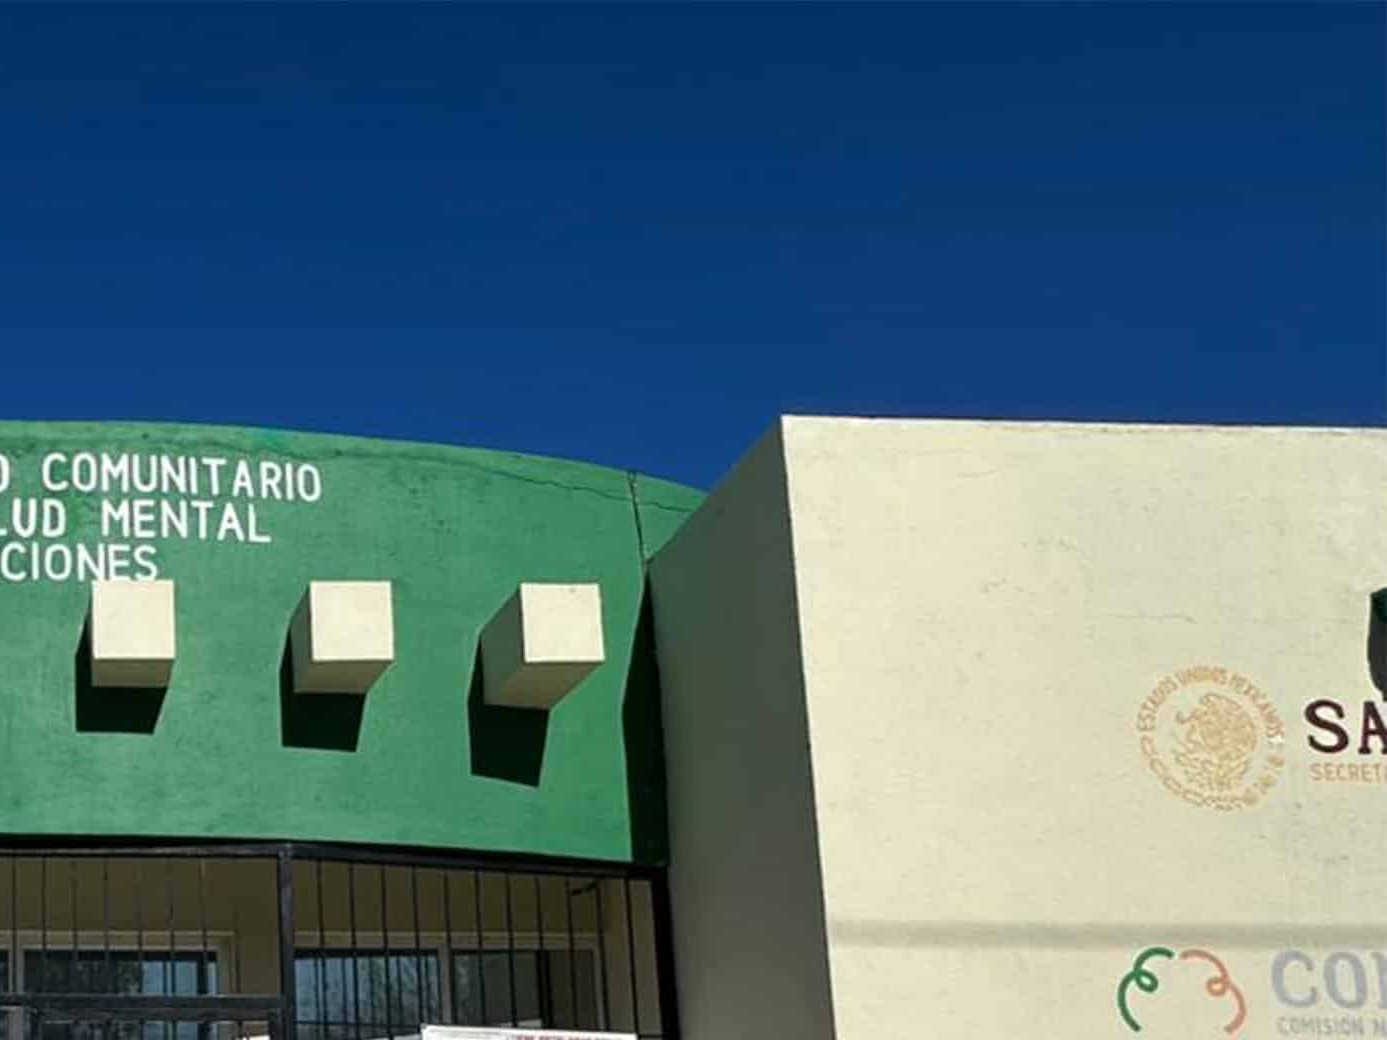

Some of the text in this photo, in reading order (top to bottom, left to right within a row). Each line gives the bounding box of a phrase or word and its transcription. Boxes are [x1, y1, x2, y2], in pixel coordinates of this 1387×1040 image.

[41, 451, 322, 502] COMUNITARIO
[102, 500, 271, 544] MENTAL
[1304, 699, 1387, 755] SA
